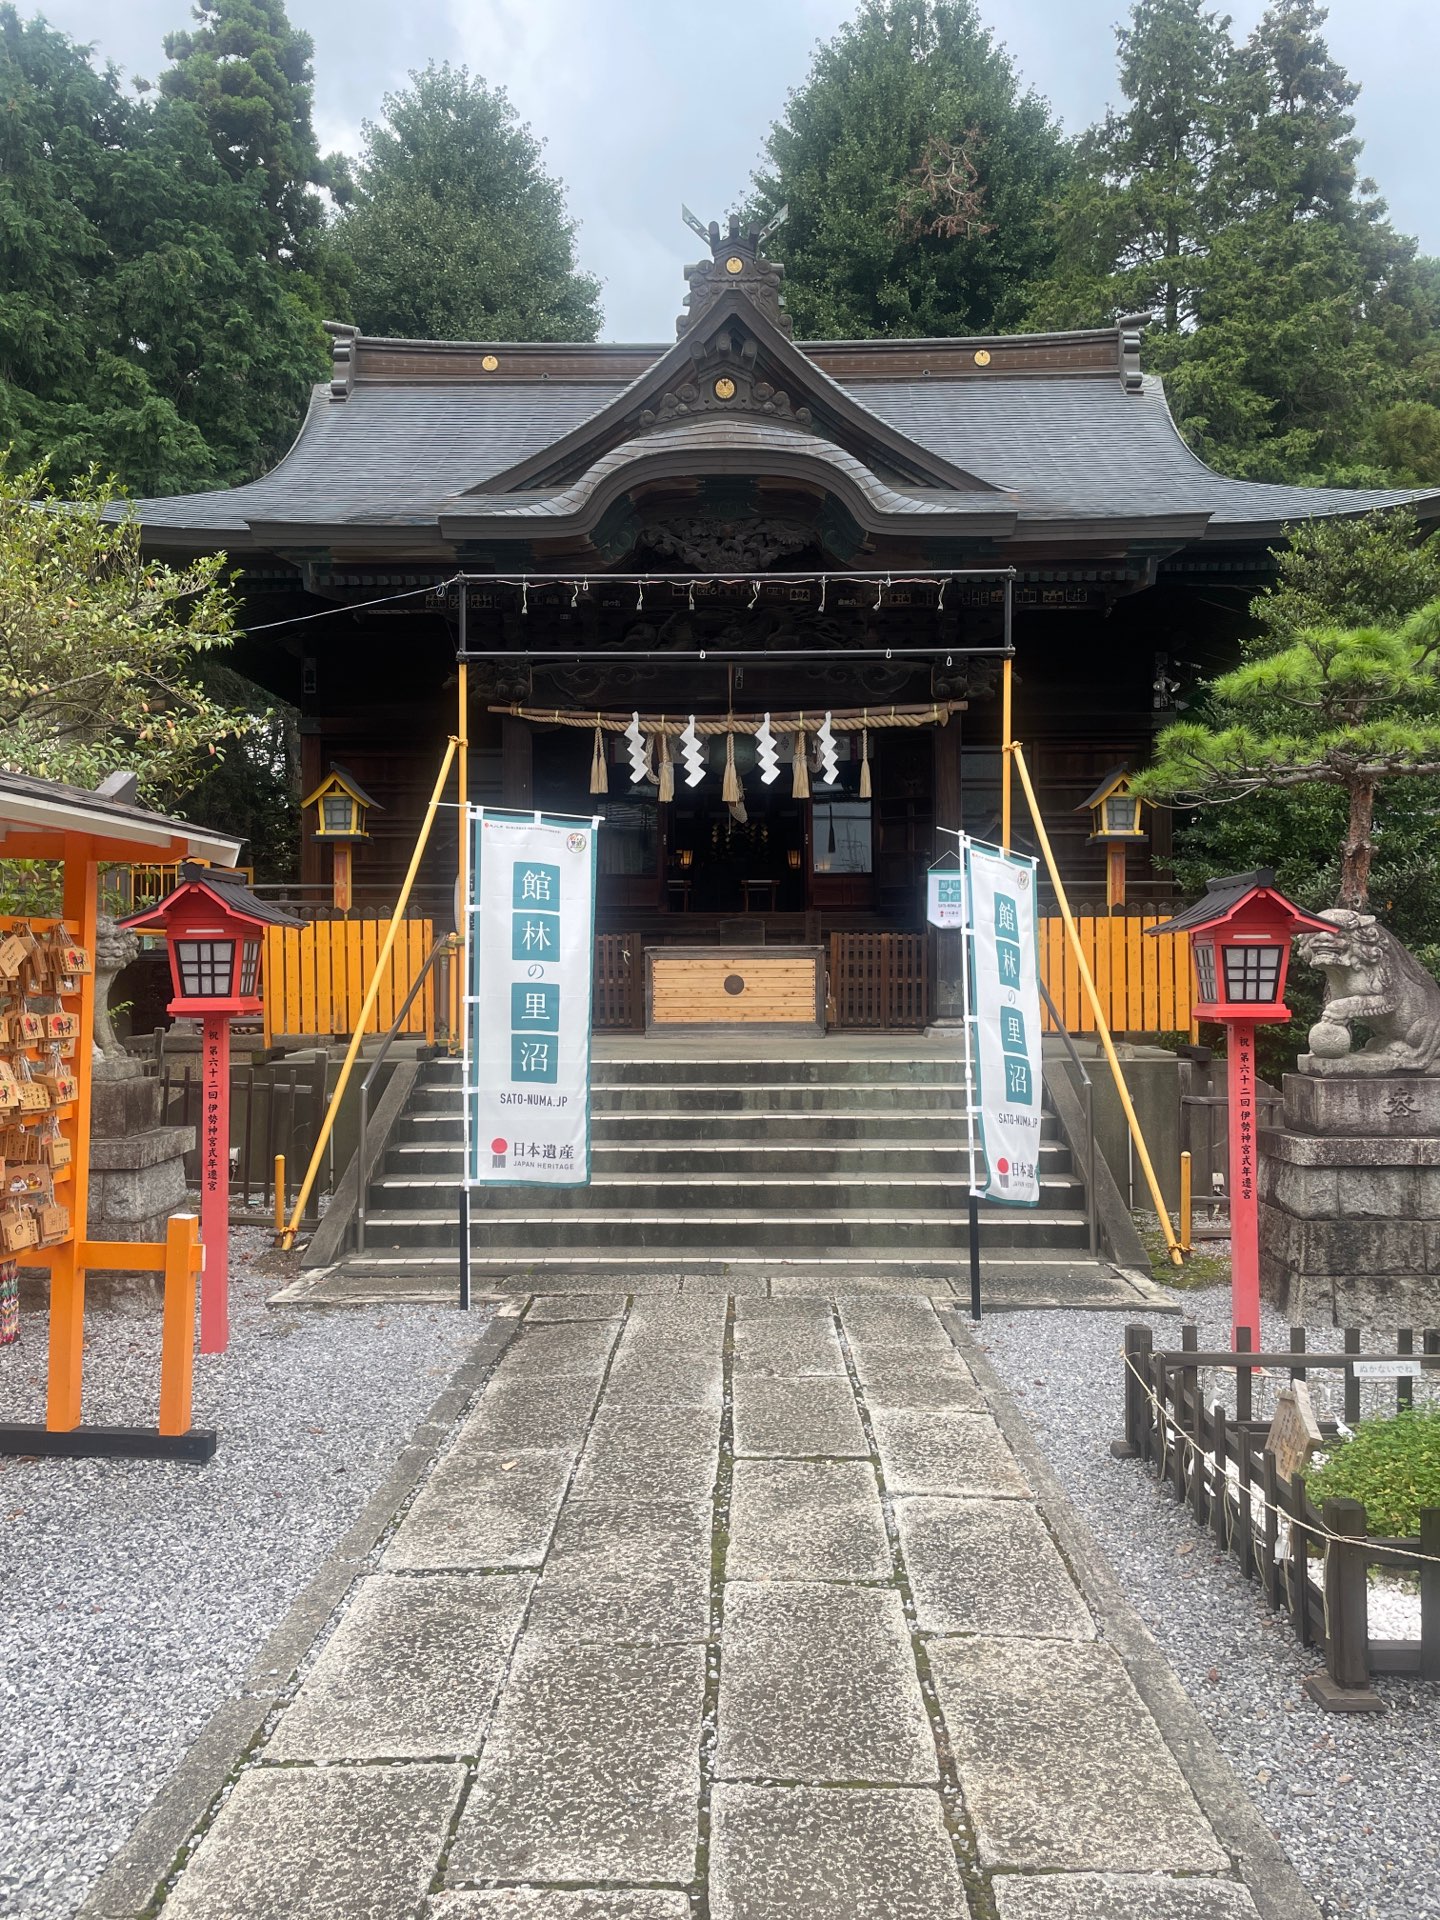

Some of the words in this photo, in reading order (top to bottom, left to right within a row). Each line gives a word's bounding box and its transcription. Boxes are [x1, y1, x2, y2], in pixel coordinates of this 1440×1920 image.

[521, 869, 552, 1072] 館林の里沼
[998, 902, 1027, 1094] 館林の里沼
[208, 1030, 218, 1040] 祝
[1239, 1036, 1250, 1047] 祝
[208, 1046, 219, 1100] 第六十二回
[1239, 1052, 1251, 1107] 第六十二回
[500, 1093, 568, 1107] SATO-NUMA.JP
[207, 1104, 218, 1191] 伊勢神宮式年遷宮
[513, 1142, 574, 1160] 日本遺産
[1240, 1110, 1252, 1199] 伊勢神宮式年遷宮
[513, 1160, 535, 1168] JAPAN
[537, 1162, 574, 1170] HERITAGE
[1011, 1162, 1036, 1179] 日本遺
[1359, 1363, 1413, 1374] ぬかないでね
